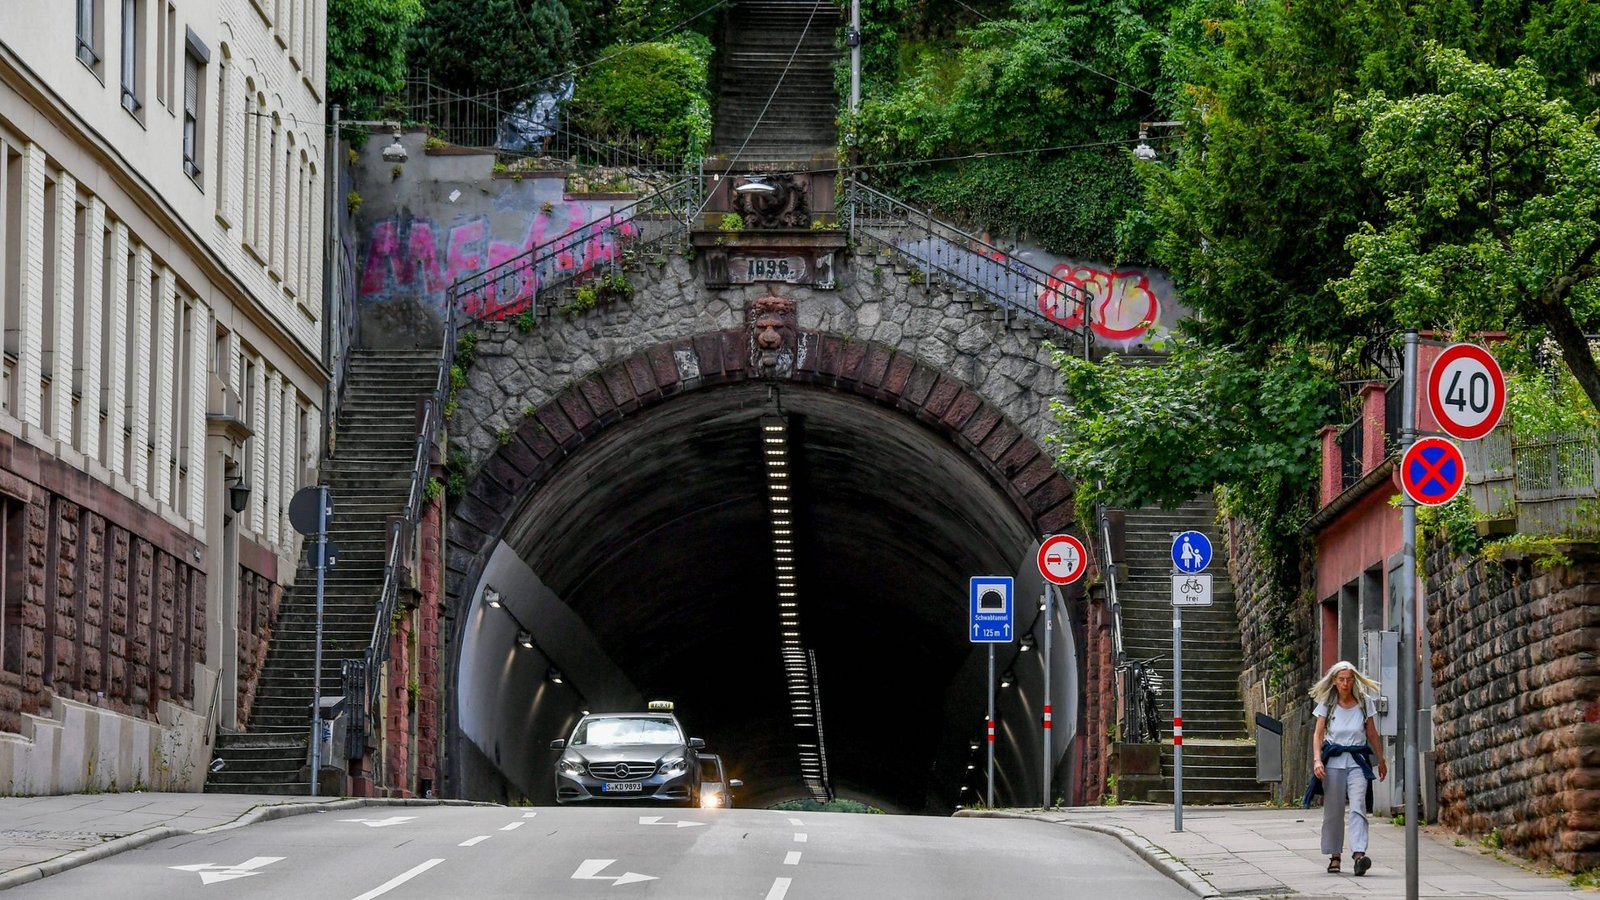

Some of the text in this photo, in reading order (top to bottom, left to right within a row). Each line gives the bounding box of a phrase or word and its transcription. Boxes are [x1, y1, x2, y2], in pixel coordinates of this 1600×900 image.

[1445, 370, 1489, 414] 40
[1186, 594, 1199, 602] frei
[983, 629, 994, 637] 125
